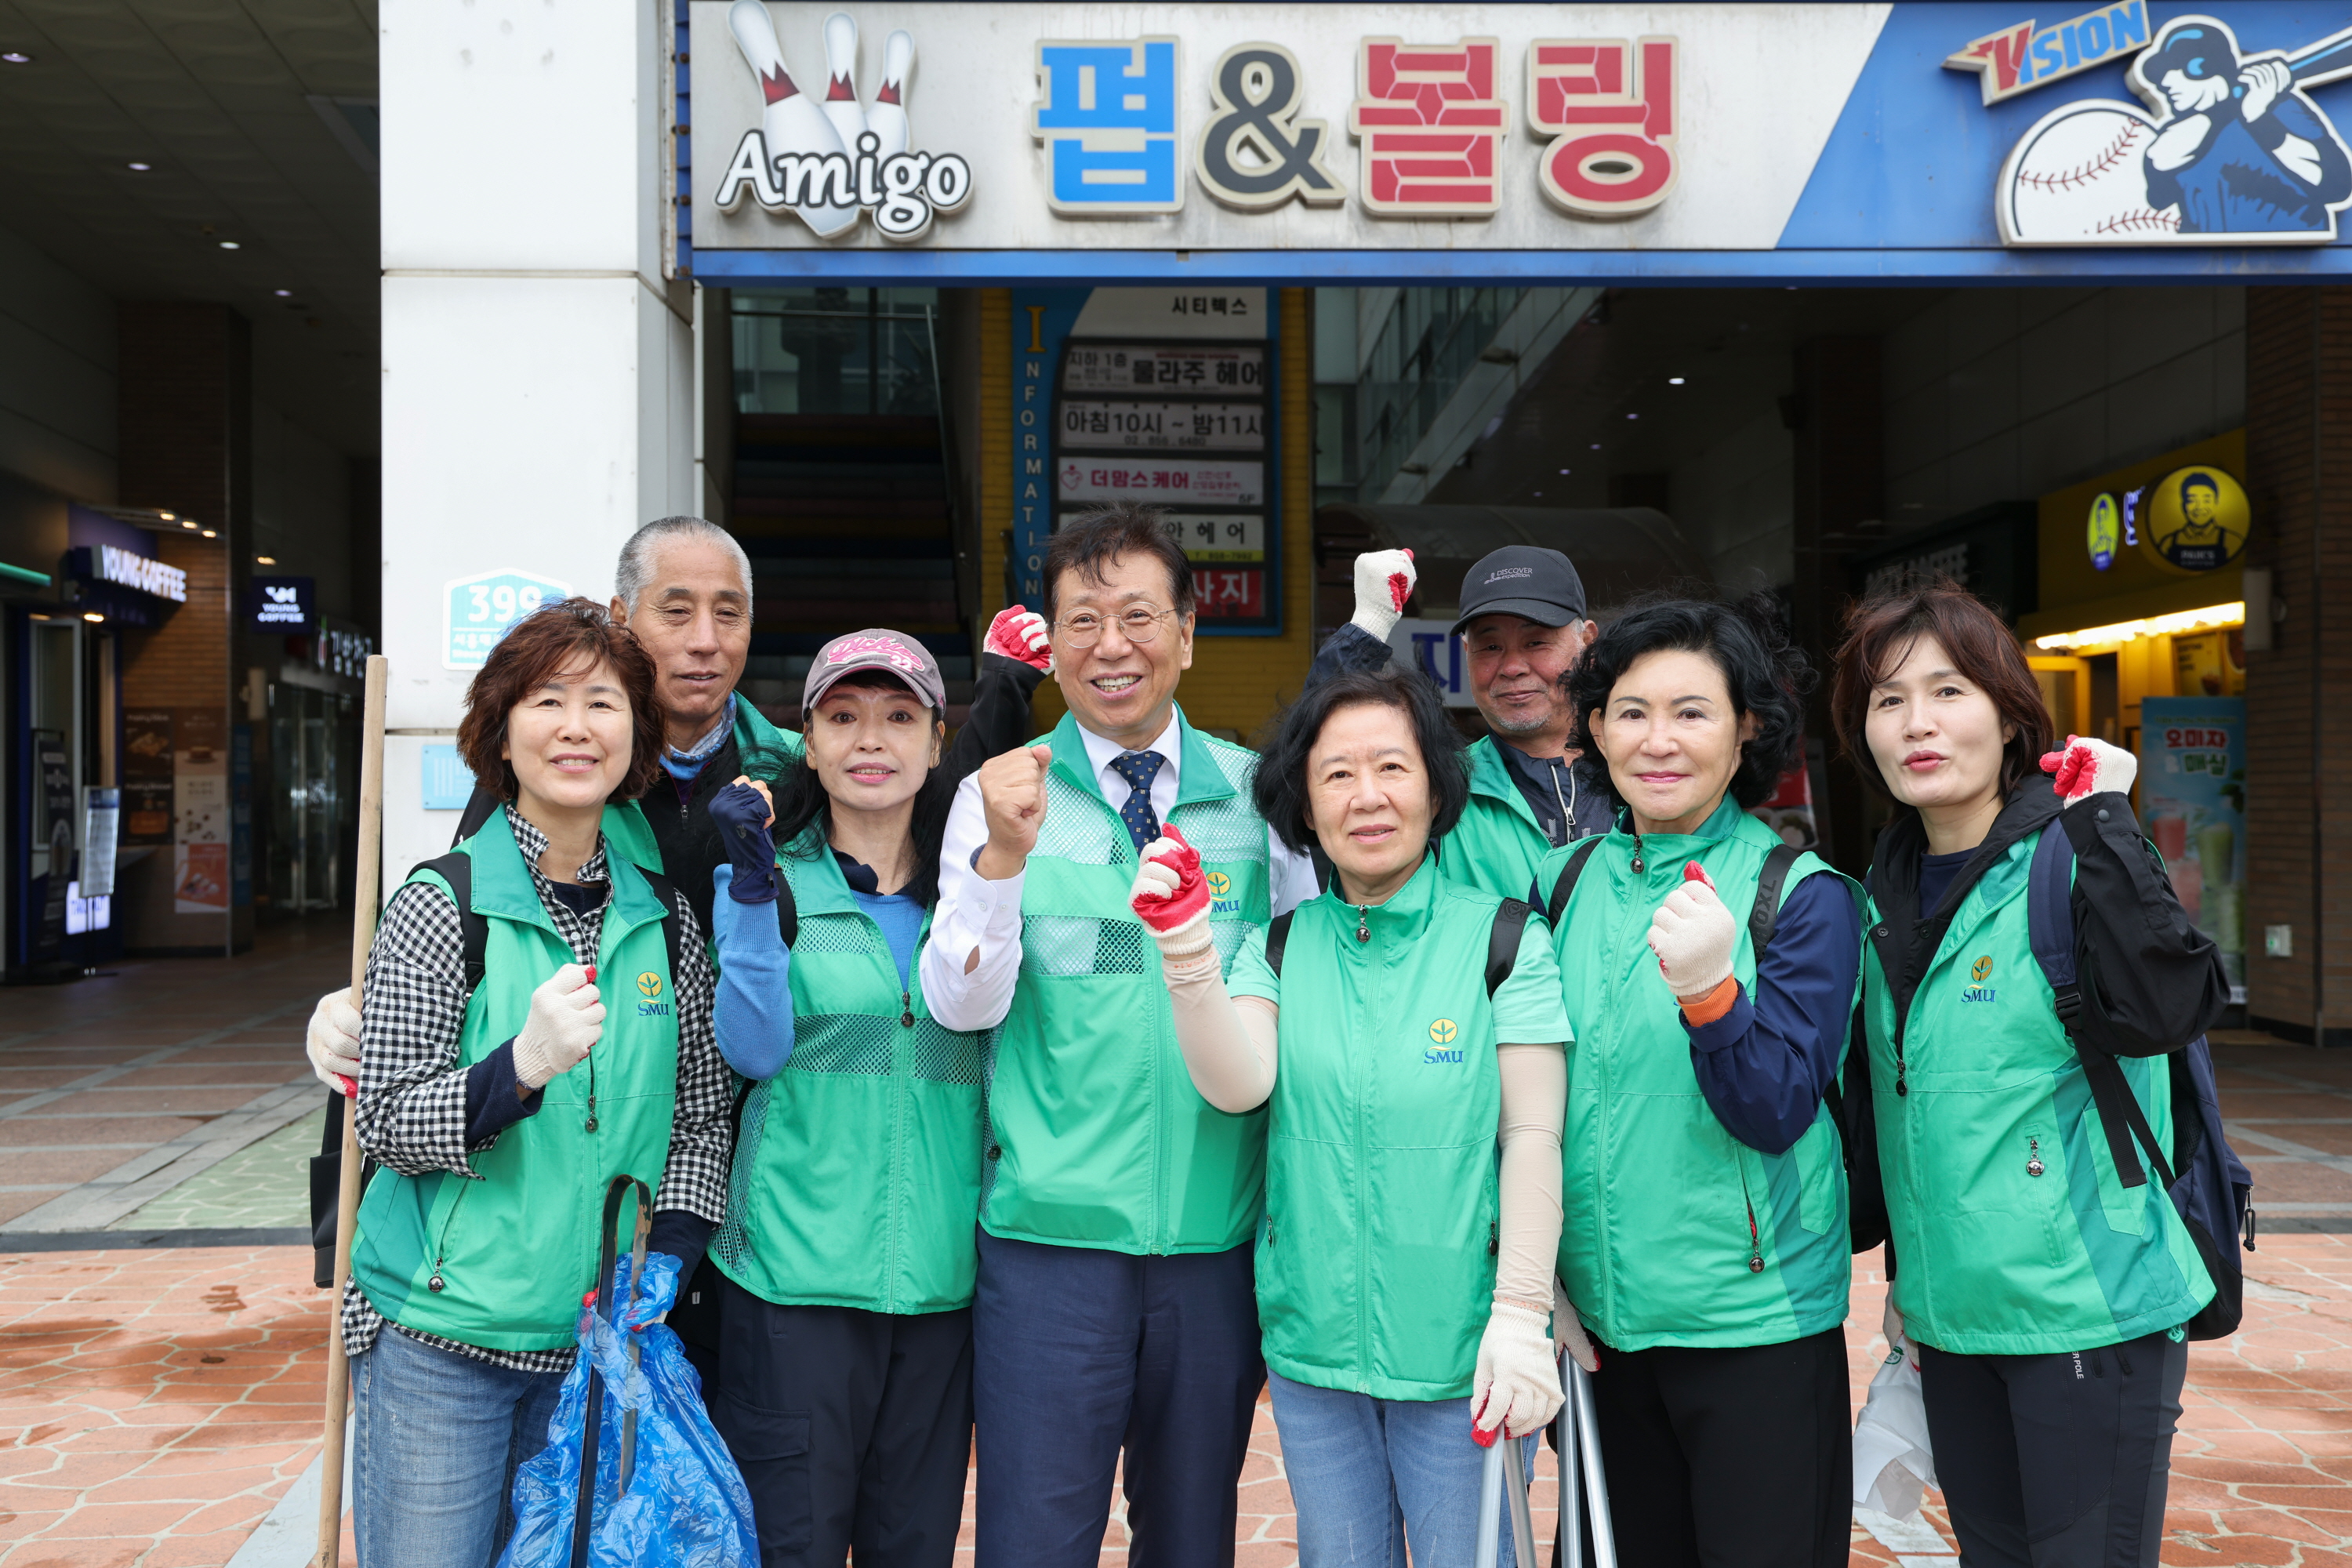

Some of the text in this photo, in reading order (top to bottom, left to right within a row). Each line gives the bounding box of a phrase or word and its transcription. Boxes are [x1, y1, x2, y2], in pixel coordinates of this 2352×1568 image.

[1965, 0, 2147, 92] VISION
[715, 129, 971, 234] Amigo
[1065, 410, 1162, 434] 아침10시
[1020, 305, 1047, 595] INFORMATION
[101, 544, 187, 603] YOUNG COFFEE
[1497, 567, 1534, 576] DISCOVER
[257, 612, 305, 623] COFFEE
[262, 602, 301, 613] YOUNG
[828, 636, 925, 672] Dickies
[891, 655, 913, 673] 22
[2165, 728, 2227, 748] 오미자
[2184, 753, 2226, 776] 매실
[1211, 899, 1240, 913] MU
[1961, 989, 1997, 1004] SMU
[637, 1004, 670, 1017] SMU
[1423, 1051, 1464, 1065] SMU
[2073, 1359, 2085, 1380] POLE
